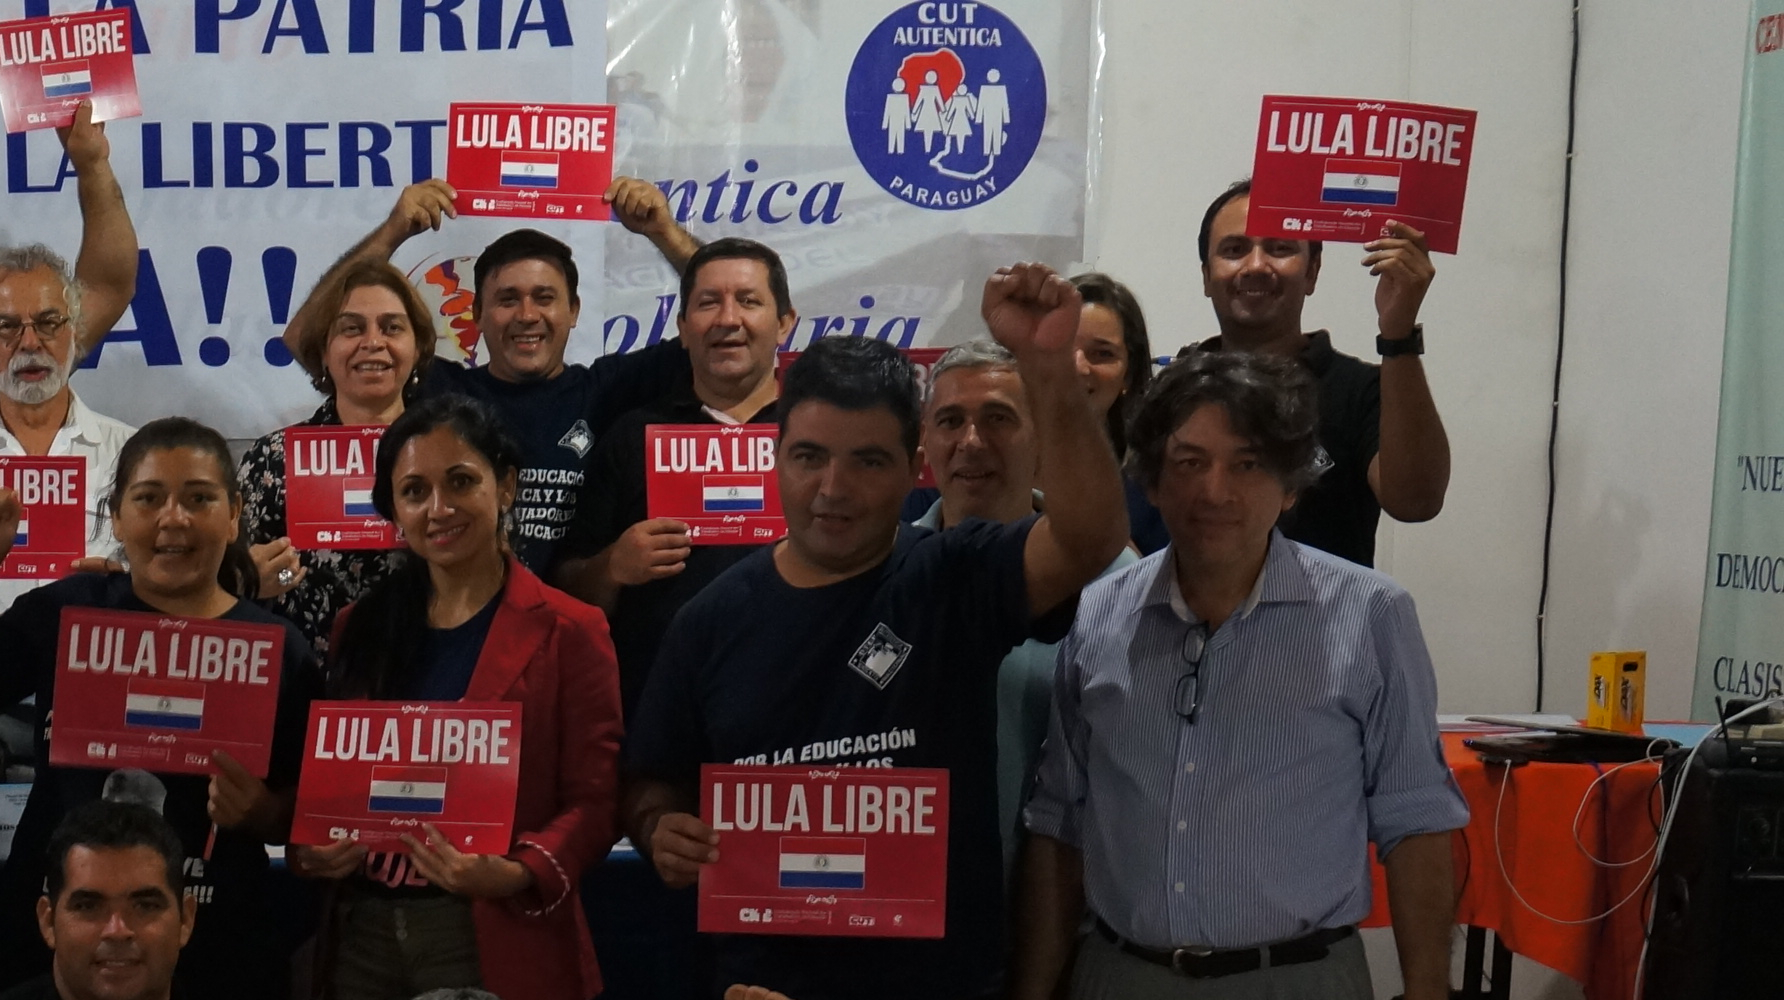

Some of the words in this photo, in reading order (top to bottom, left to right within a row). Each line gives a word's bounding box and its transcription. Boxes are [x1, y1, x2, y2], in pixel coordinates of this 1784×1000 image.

[194, 0, 574, 54] PATRIA
[917, 2, 978, 25] CUT
[60, 20, 126, 59] LIBRE
[894, 26, 1002, 47] AUTENTICA
[457, 114, 520, 150] LULA
[529, 117, 606, 152] LIBRE
[1267, 111, 1354, 156] LULA
[1364, 115, 1465, 166] LIBRE
[889, 175, 997, 207] PARAGUAY
[294, 438, 369, 477] LULA
[654, 437, 723, 474] LULA
[67, 623, 158, 677] LULA
[168, 634, 274, 686] LIBRE
[314, 715, 400, 763] LULA
[410, 718, 512, 765] LIBRE
[773, 747, 795, 766] LA
[800, 726, 917, 762] EDUCACIÓN
[712, 783, 811, 833] LULA
[822, 784, 937, 835] LIBRE
